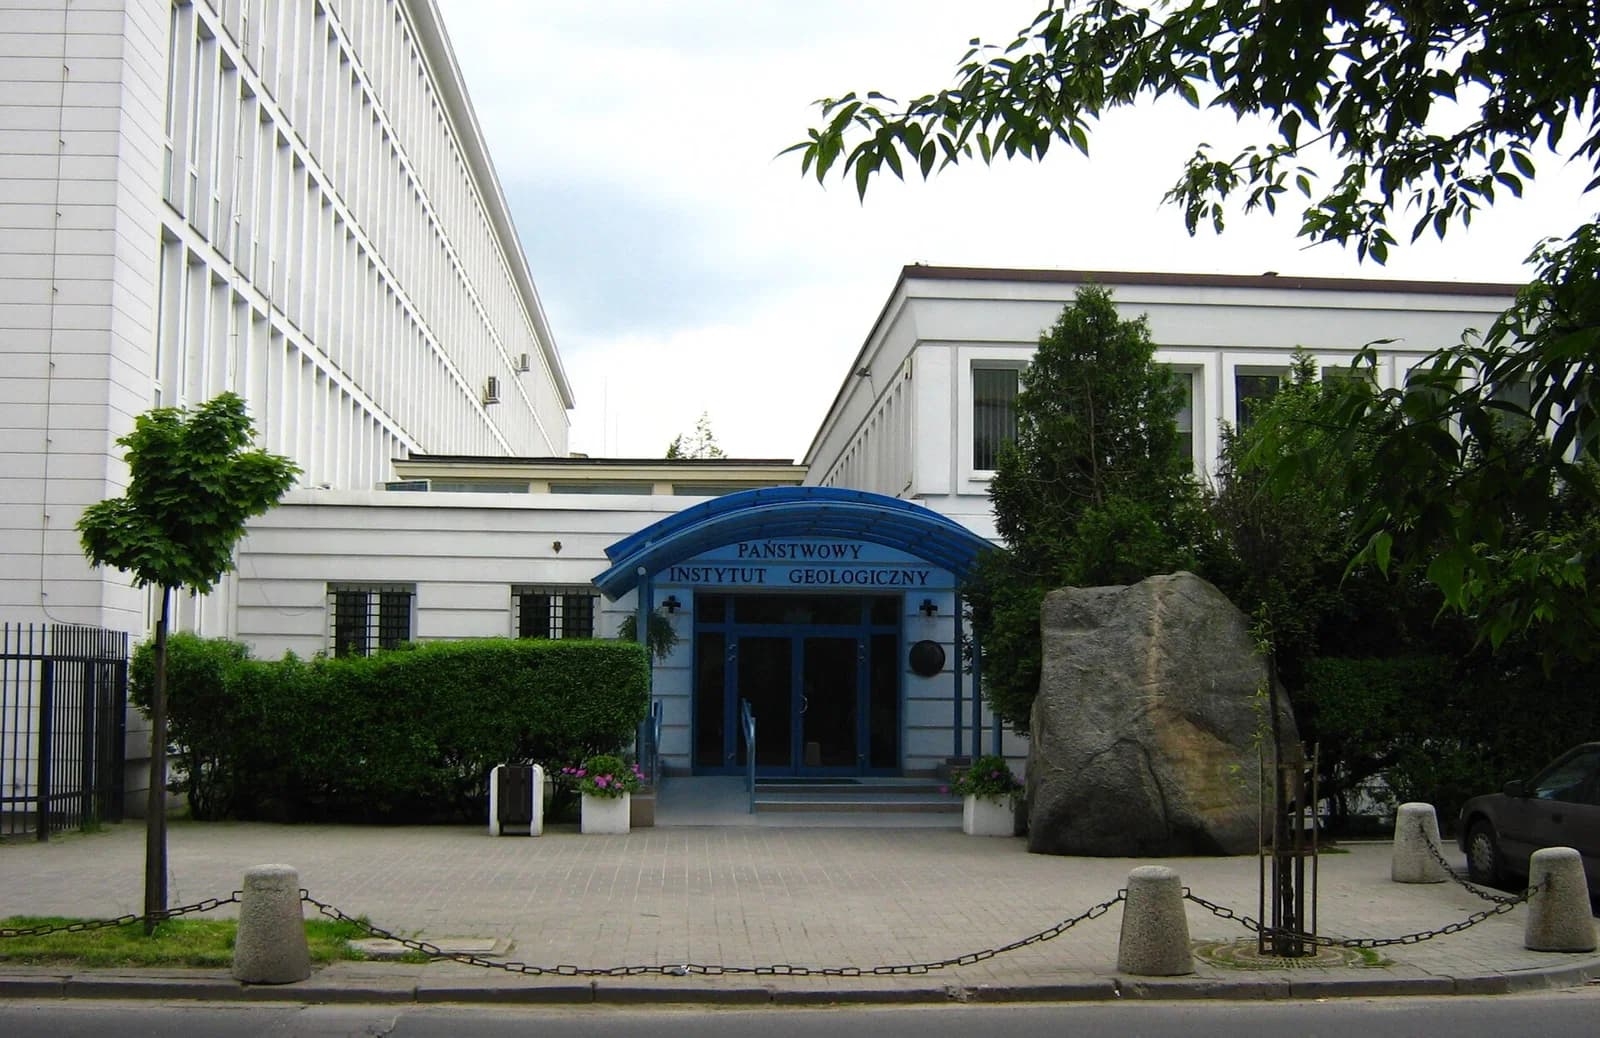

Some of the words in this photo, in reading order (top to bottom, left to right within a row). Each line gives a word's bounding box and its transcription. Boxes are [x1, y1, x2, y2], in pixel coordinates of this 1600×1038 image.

[738, 540, 863, 559] PAŃSTWOWY
[669, 566, 767, 584] INSTYTUT
[789, 568, 930, 585] GEOLOGICZNY
